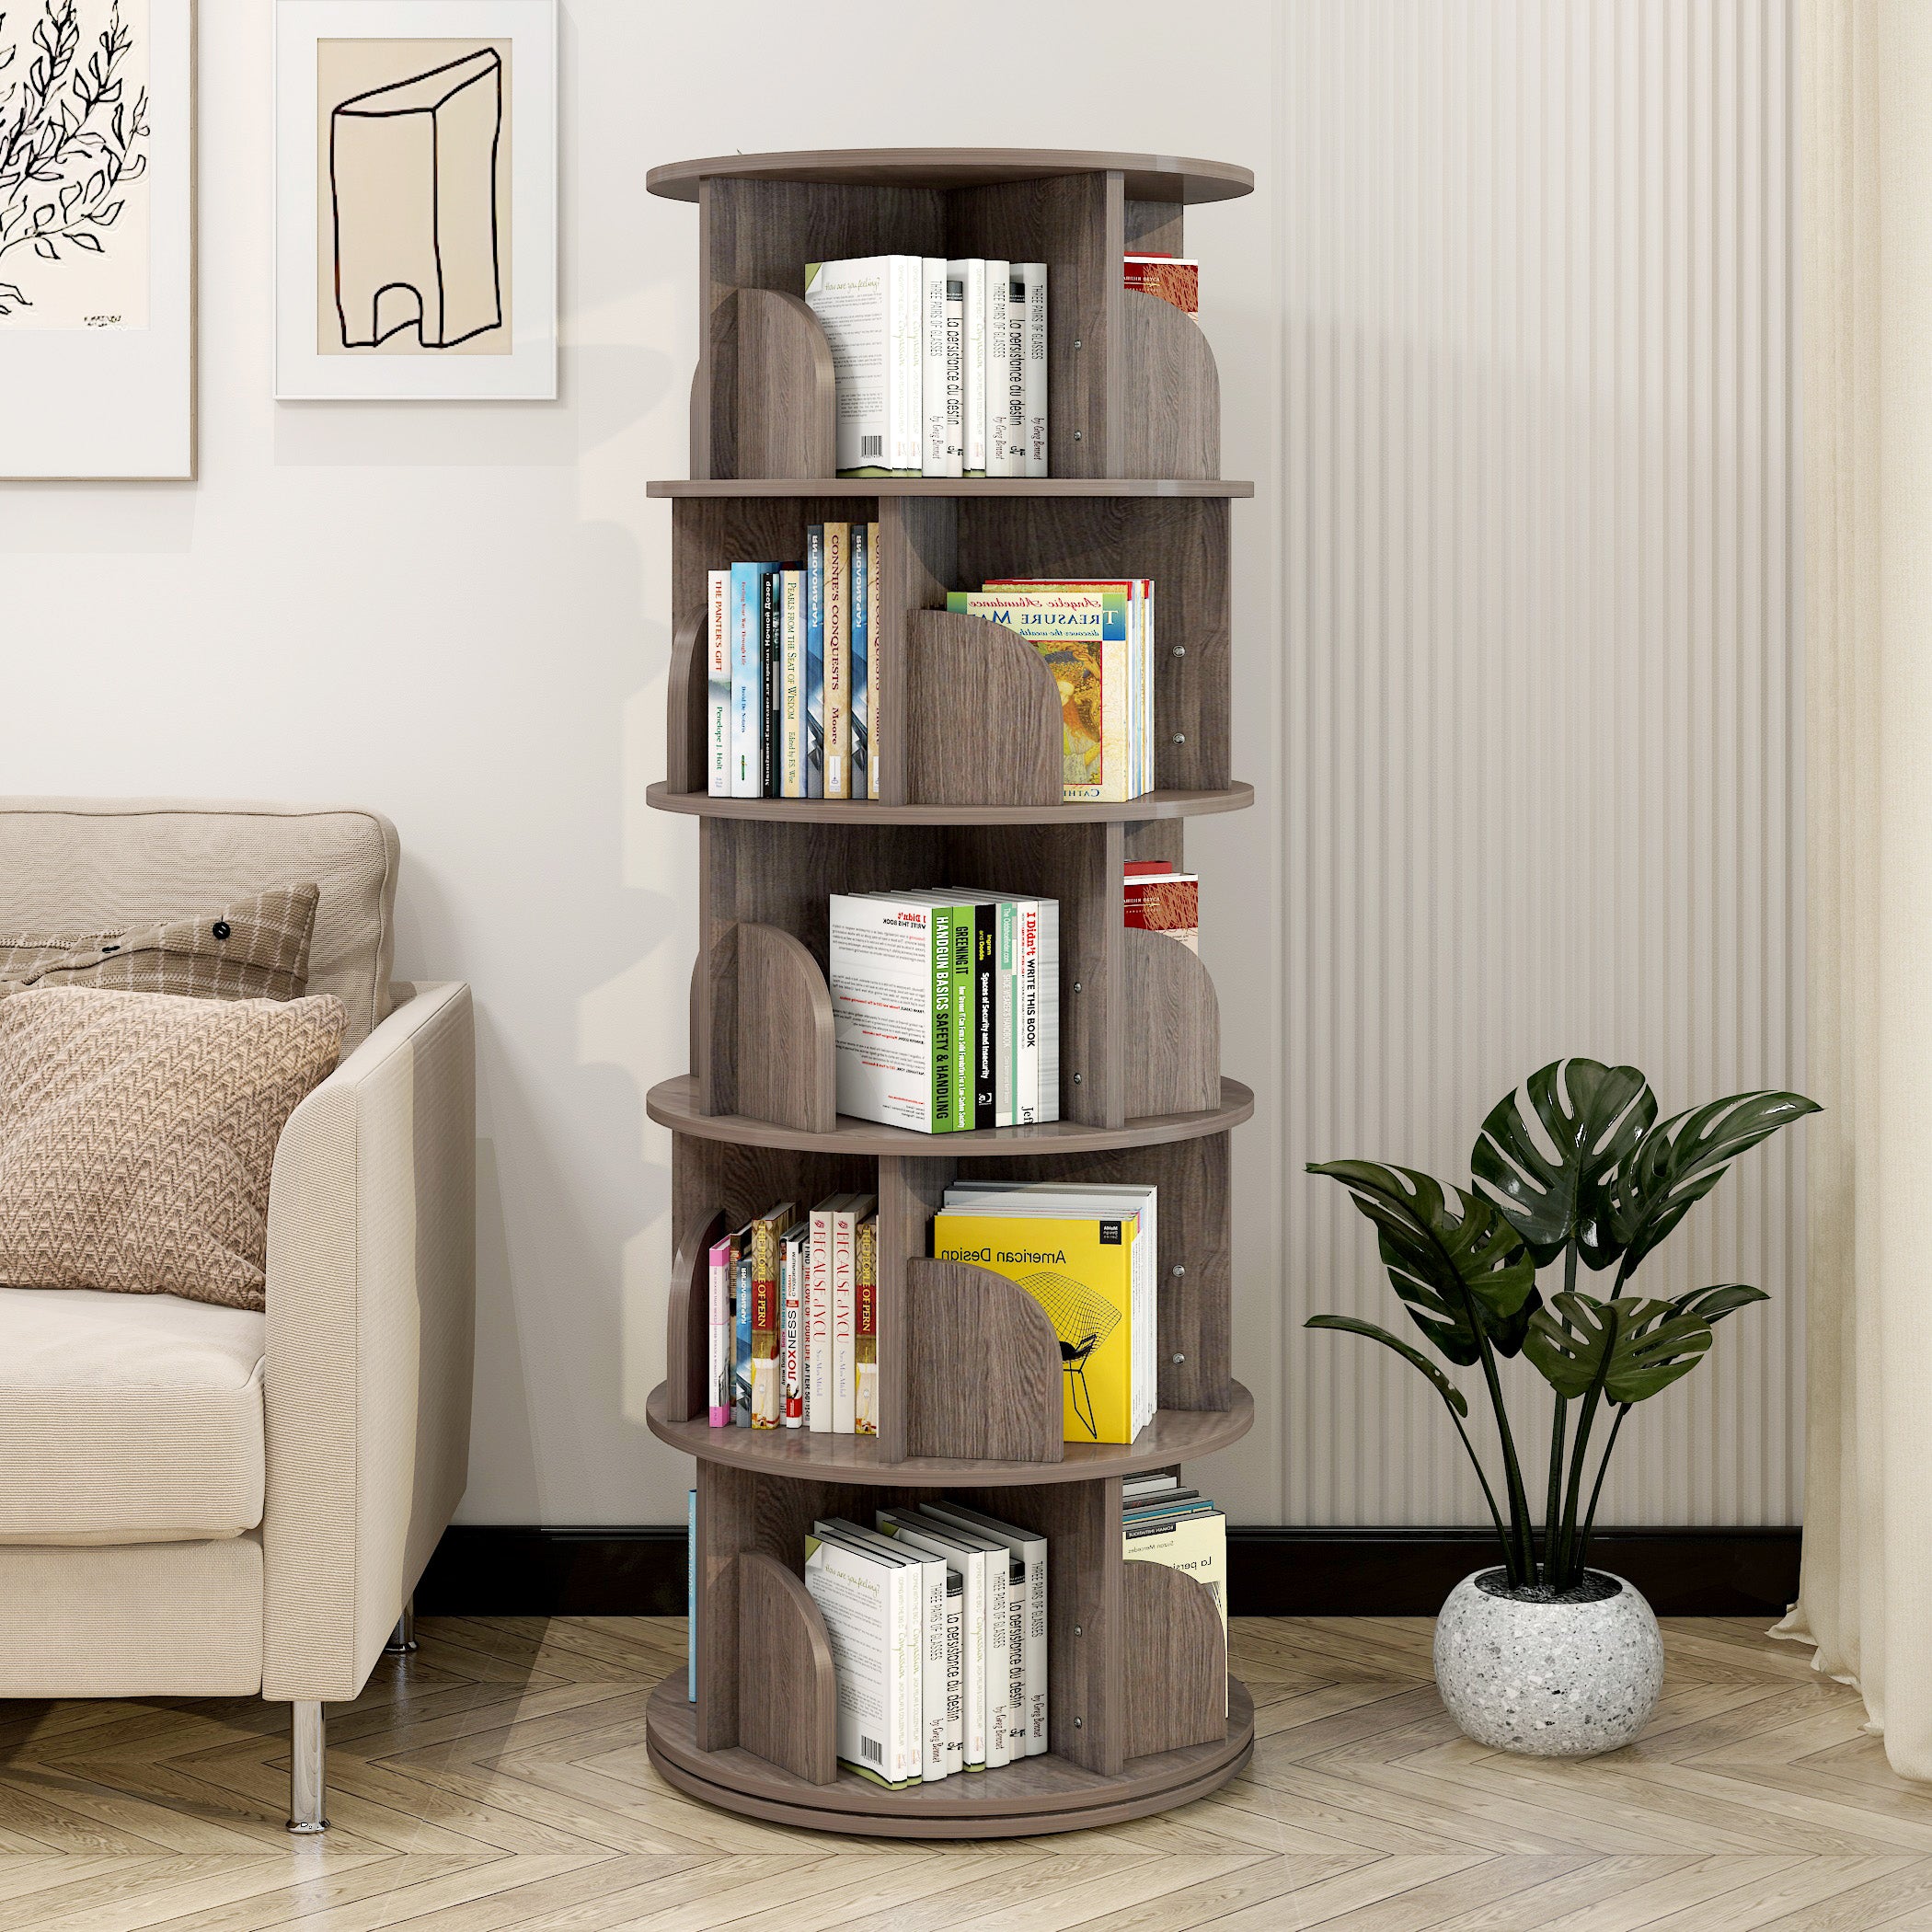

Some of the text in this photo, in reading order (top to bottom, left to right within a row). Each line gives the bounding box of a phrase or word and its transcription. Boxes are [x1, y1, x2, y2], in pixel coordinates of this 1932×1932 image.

[931, 281, 942, 299] THREE
[1031, 284, 1043, 304] THREE
[931, 301, 942, 318] PAIRS
[947, 317, 962, 328] La
[1031, 305, 1043, 322] PAIRS
[1010, 318, 1025, 329] La
[931, 329, 942, 357] GLASSES
[947, 330, 962, 382] persistance
[1010, 331, 1025, 382] persistance
[1031, 333, 1043, 360] GLASSES
[947, 384, 962, 396] du
[1010, 385, 1025, 397] du
[947, 398, 962, 425] destin
[1010, 399, 1025, 426] destin
[930, 424, 943, 438] Greg
[1031, 417, 1044, 460] by Greg Bennet
[932, 439, 943, 460] Bennet
[765, 581, 773, 610] Дозор
[831, 535, 839, 745] CONNIE'S CONQUESTS Moore
[955, 926, 969, 965] GREENING
[1027, 920, 1036, 956] Didn't
[981, 972, 989, 995] Spaces
[1027, 959, 1036, 990] WRITE
[1027, 992, 1036, 1016] THIS
[936, 916, 949, 1120] HANDGUN BASICS SAFETY & HANDLING
[981, 1005, 989, 1032] Security
[981, 1032, 989, 1045] and
[1027, 1018, 1036, 1047] BOOK
[981, 1045, 989, 1078] Insecurity
[758, 1224, 766, 1327] THE PEOPLE OF PERN
[814, 1232, 826, 1343] BECAUSE of YOU
[837, 1233, 849, 1343] BECAUSE of YOU
[862, 1228, 871, 1332] THE PEOPLE OF PERN
[804, 1306, 811, 1317] OF
[930, 1582, 942, 1604] THREE
[1031, 1560, 1043, 1638] THREE PAIRS OF GLASSES
[930, 1604, 942, 1623] PAIRS
[947, 1612, 962, 1623] La
[930, 1633, 942, 1662] GLASSES
[947, 1627, 962, 1678] persistance
[947, 1681, 962, 1693] du
[947, 1695, 962, 1722] destin
[1031, 1693, 1045, 1738] by Greg Bennet
[931, 1719, 944, 1763] by Greg Bennet
